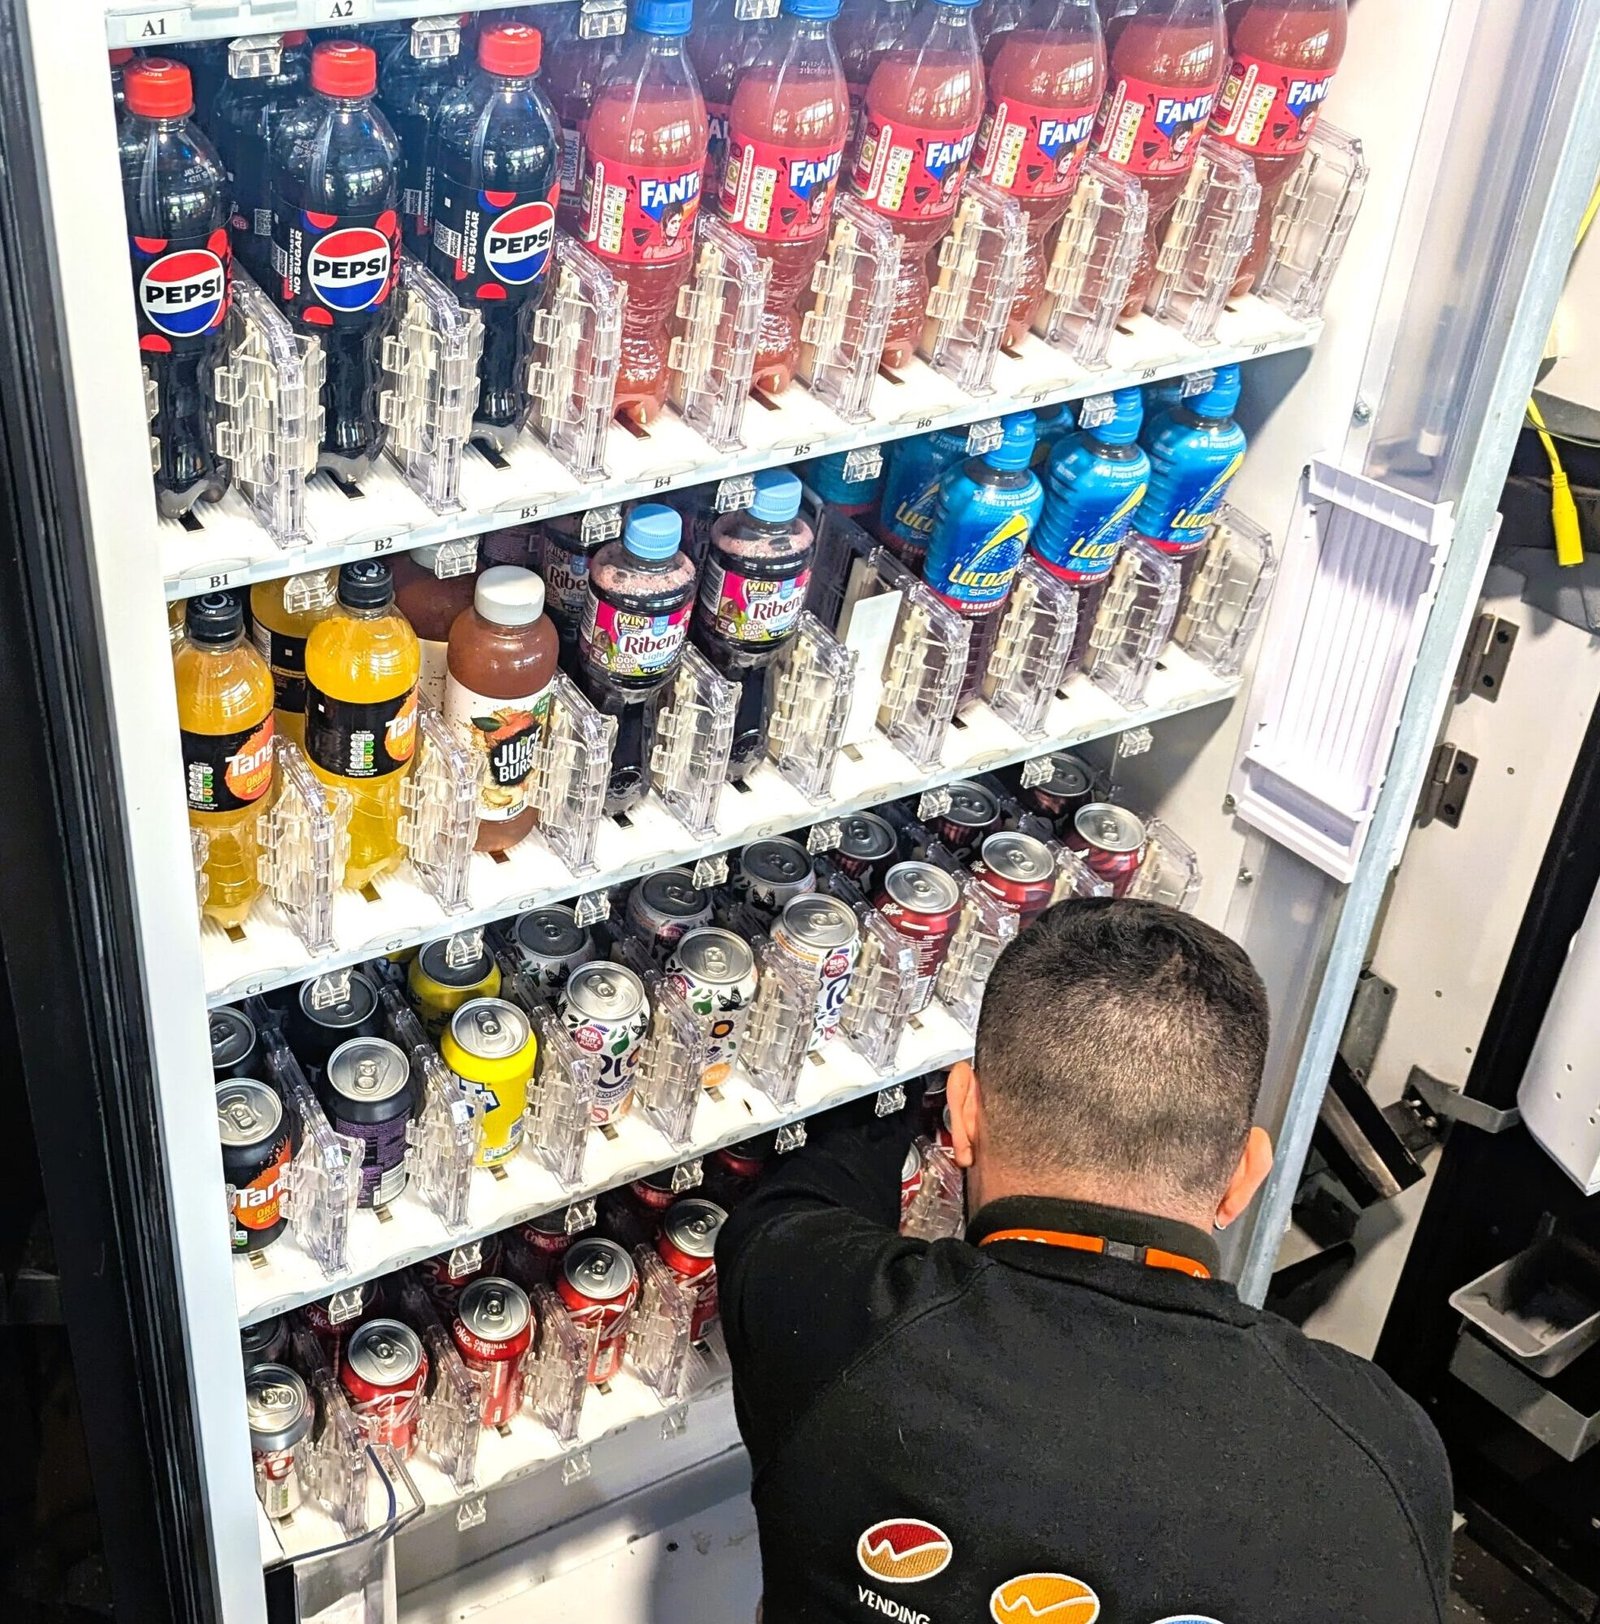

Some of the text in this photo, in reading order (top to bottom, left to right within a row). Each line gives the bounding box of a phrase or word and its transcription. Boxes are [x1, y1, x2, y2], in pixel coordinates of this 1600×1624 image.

[329, 1, 354, 18] A2
[141, 18, 166, 37] A1
[467, 211, 480, 274] NO SUGAR
[489, 226, 552, 254] PEPSI
[293, 230, 302, 295] NO SUGAR
[313, 255, 387, 279] PEPSI
[145, 275, 221, 304] PEPSI
[1252, 344, 1267, 355] B9
[1141, 367, 1157, 379] B8
[1032, 392, 1048, 404] B7
[916, 418, 932, 429] B6
[794, 444, 811, 457] B5
[653, 476, 671, 489] B4
[520, 506, 538, 519] B3
[373, 537, 393, 552] B2
[209, 573, 229, 589] B1
[549, 566, 587, 591] Ribe
[746, 581, 774, 592] WIN
[618, 614, 646, 629] WIN
[624, 630, 682, 655] Ribena
[613, 656, 637, 664] 1000
[642, 651, 665, 661] Light
[500, 755, 532, 783] BURS
[757, 826, 773, 837] C5
[639, 862, 656, 873] C4
[518, 898, 535, 910] C3
[385, 938, 403, 951] C2
[245, 982, 263, 995] C1
[453, 1318, 471, 1346] Coke
[474, 1339, 508, 1350] ORIGINAL
[858, 1584, 931, 1624] VENDING
